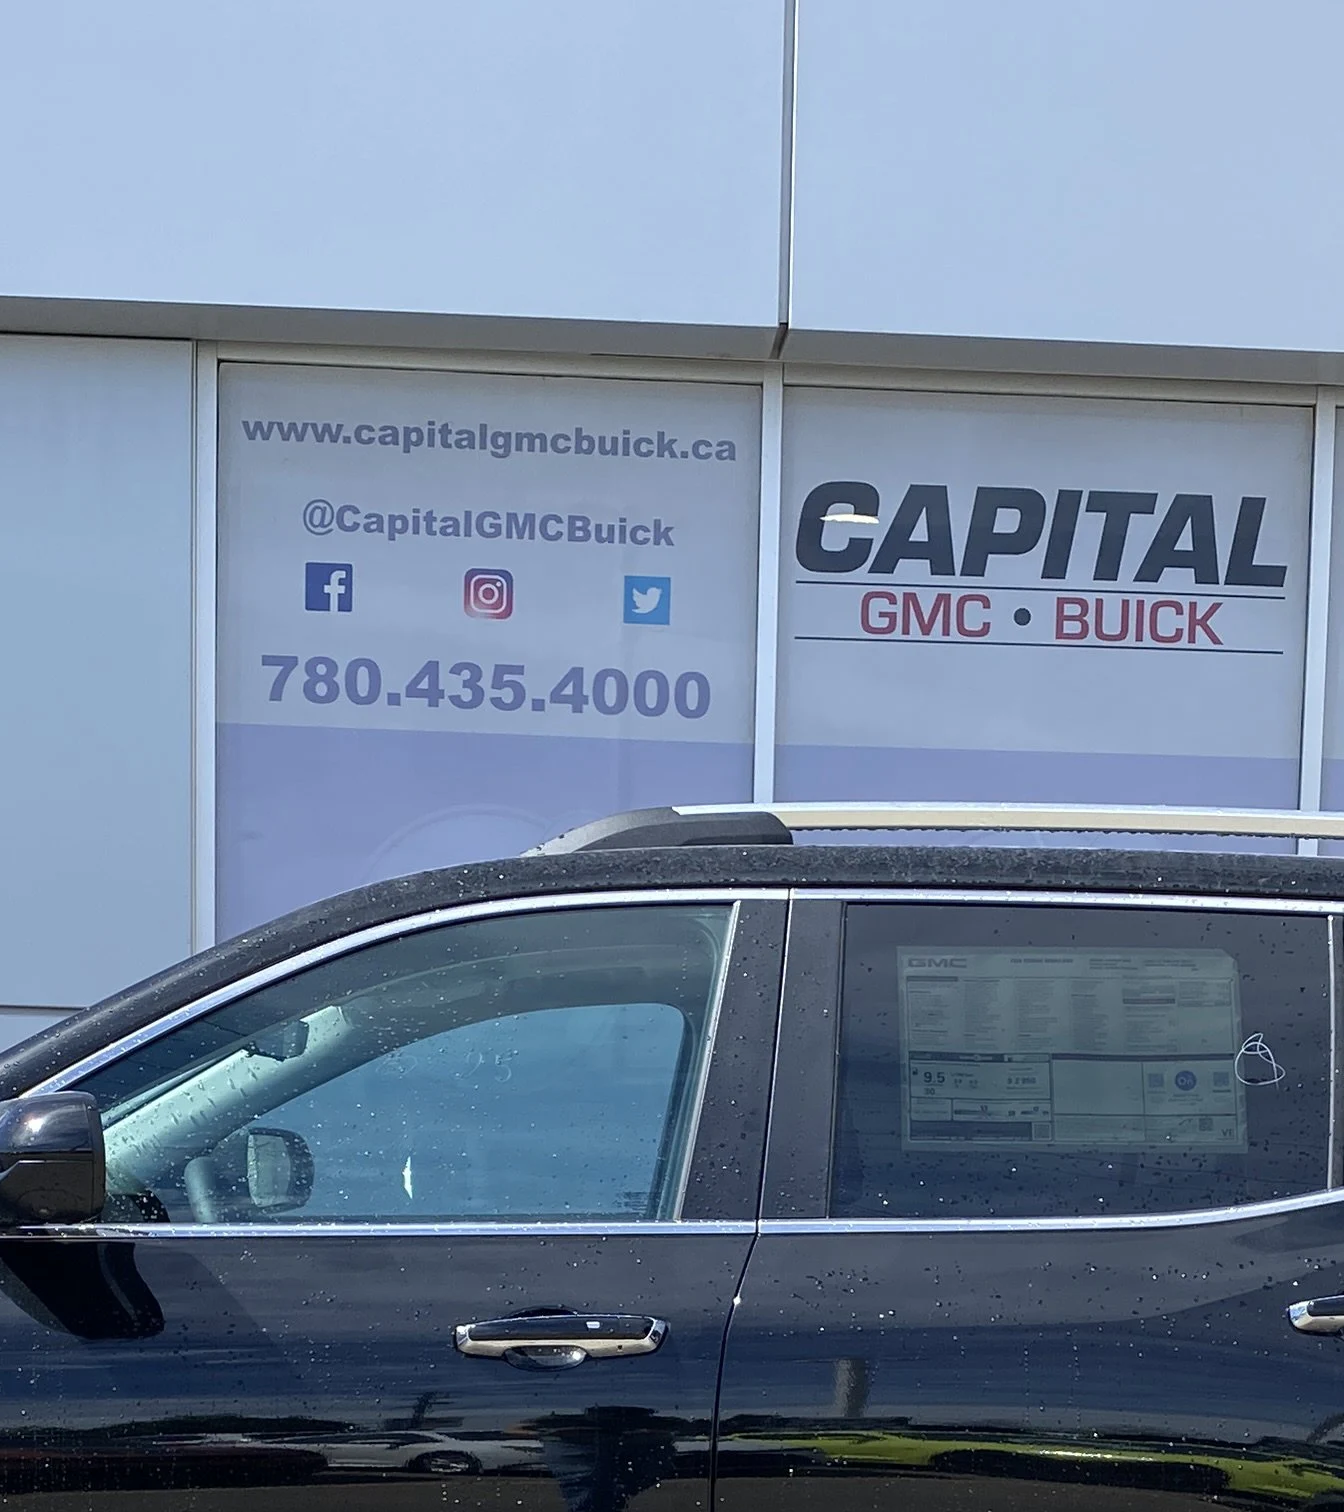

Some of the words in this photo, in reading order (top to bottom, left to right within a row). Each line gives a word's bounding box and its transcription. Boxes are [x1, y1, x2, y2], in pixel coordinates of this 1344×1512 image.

[242, 417, 737, 463] www.capitalgmcbuick.ca
[302, 498, 675, 547] @CapitalGMCBuick
[794, 480, 1288, 588] CAPITAL
[859, 590, 991, 637] GMC
[1054, 596, 1224, 646] BUICK
[260, 654, 711, 720] 780.435.4000
[907, 957, 968, 969] GMC
